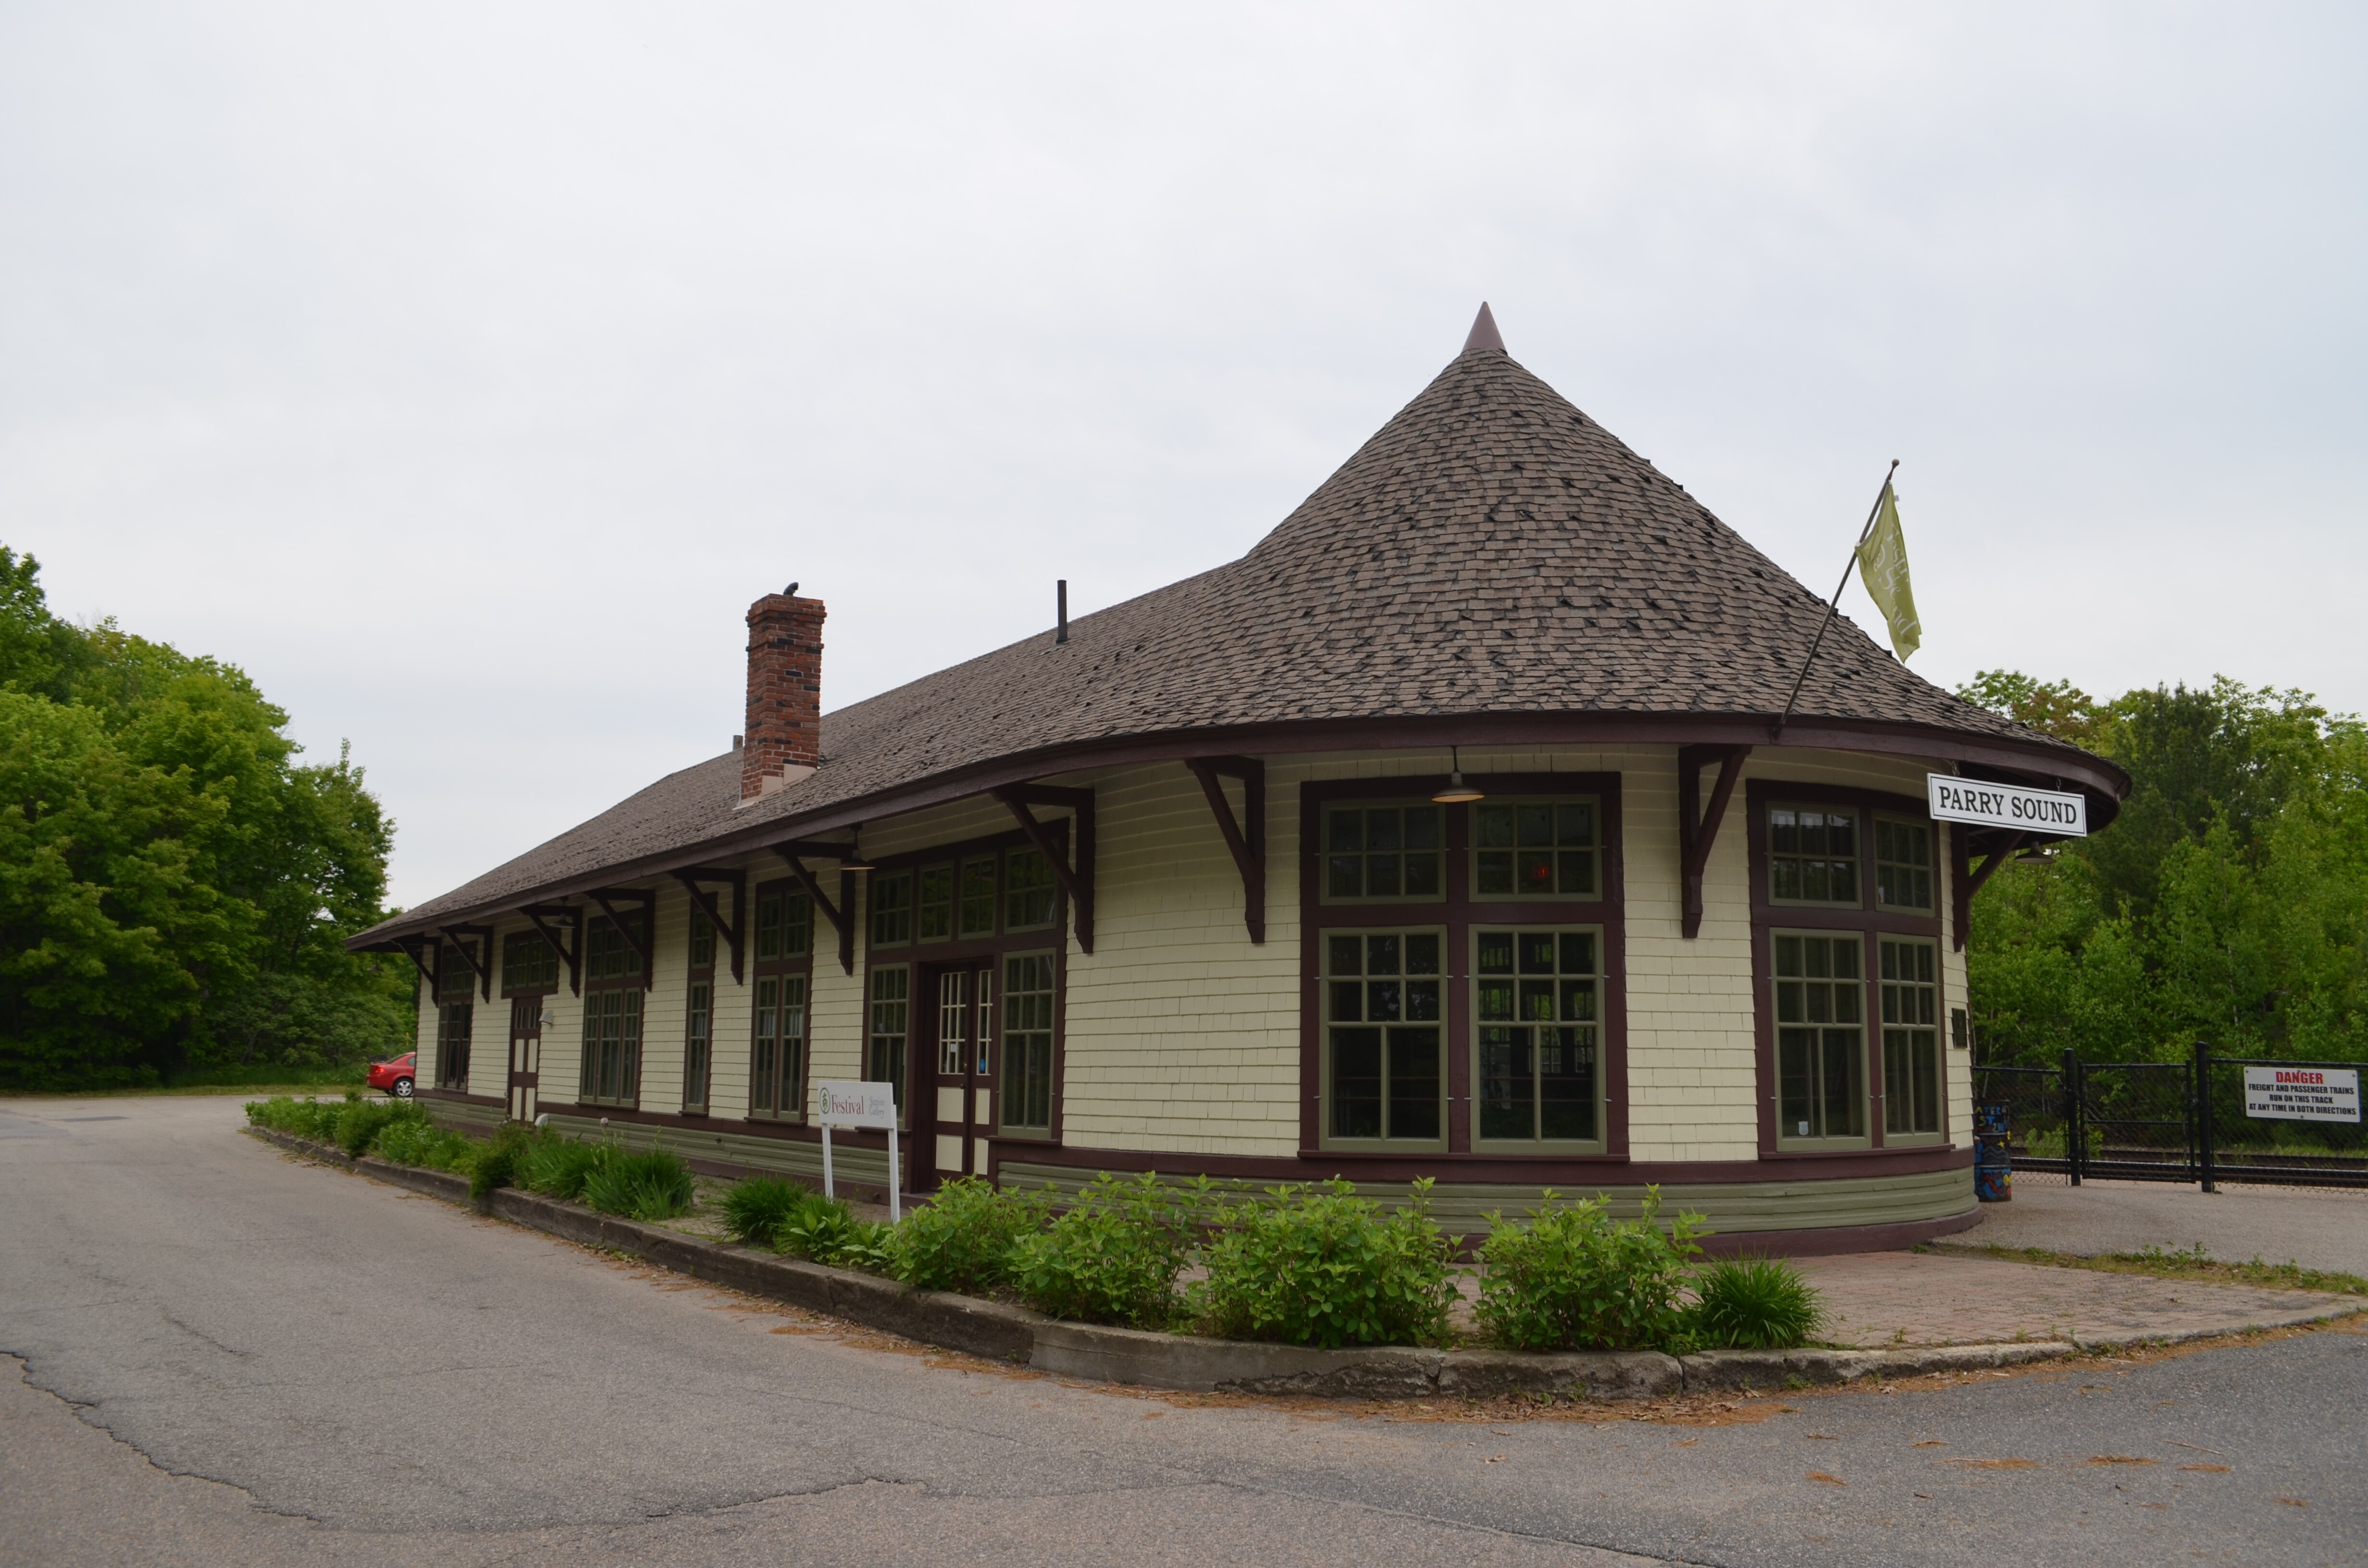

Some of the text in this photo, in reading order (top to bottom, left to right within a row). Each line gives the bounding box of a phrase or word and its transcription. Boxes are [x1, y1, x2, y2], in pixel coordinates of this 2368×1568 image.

[1938, 786, 2076, 824] PARRY SOUND
[2276, 1072, 2323, 1084] DANGER
[2291, 1086, 2328, 1094] PASSENGER
[2330, 1087, 2354, 1095] TRAINS
[831, 1094, 864, 1115] Festival
[2297, 1105, 2314, 1114] BOTH
[2316, 1106, 2356, 1115] DIRECTIONS
